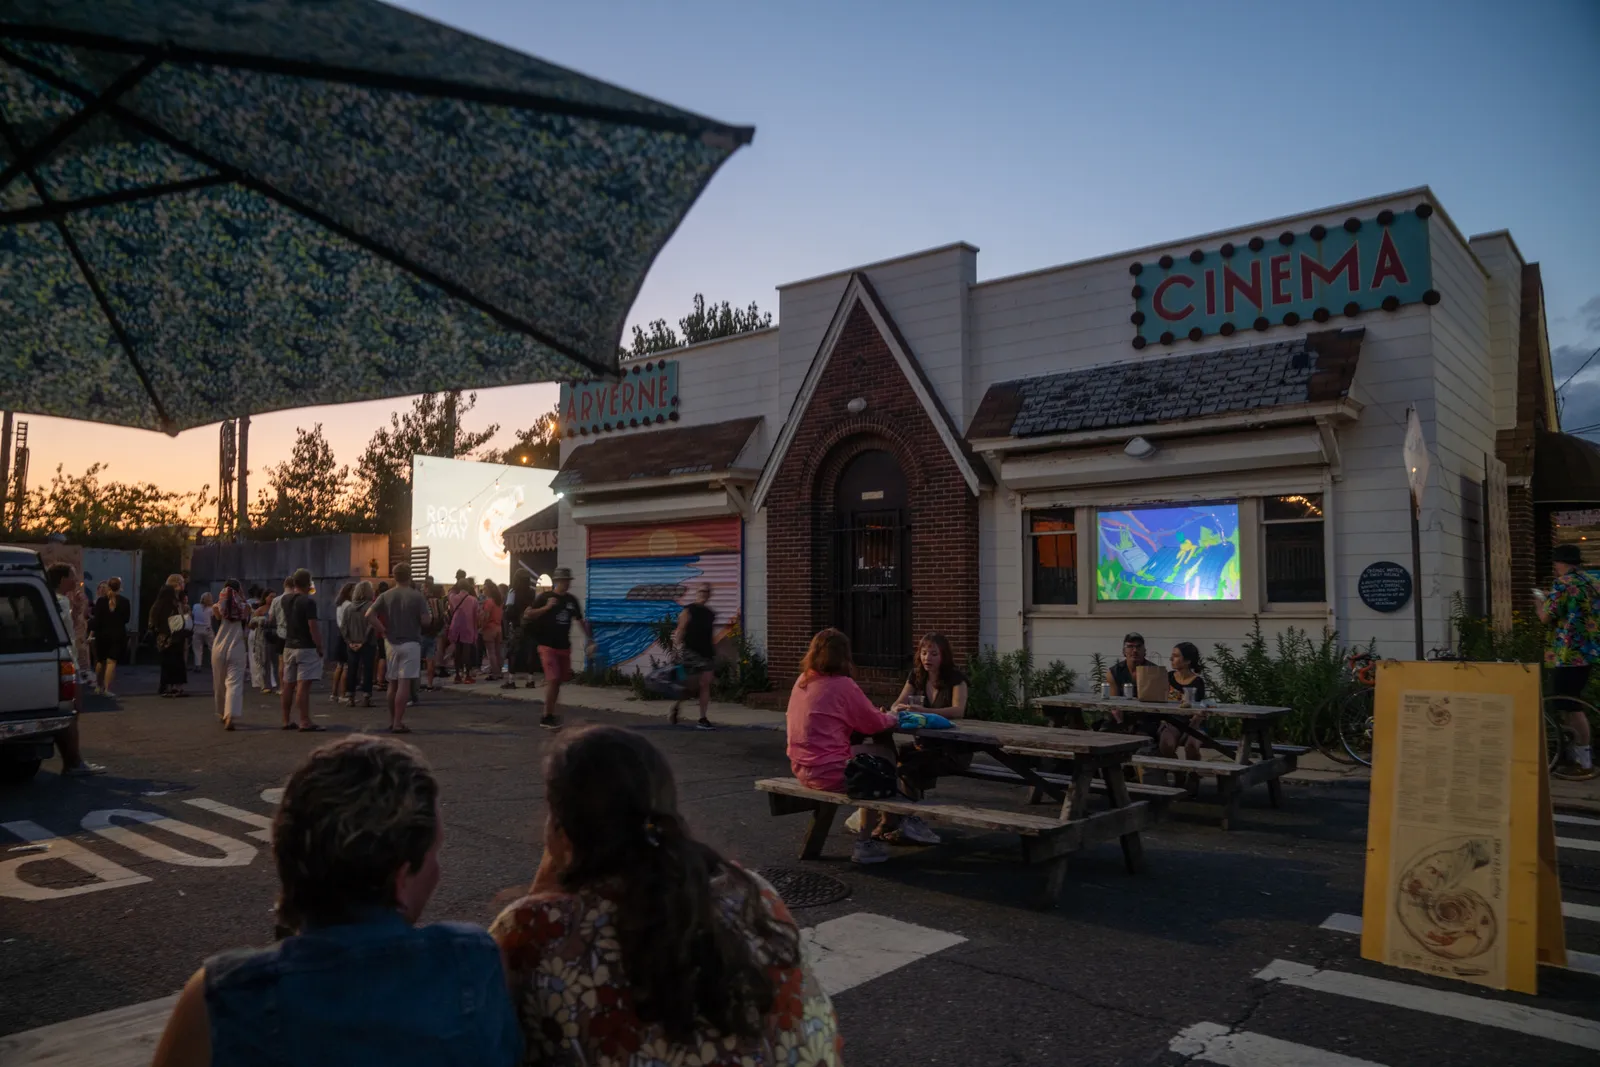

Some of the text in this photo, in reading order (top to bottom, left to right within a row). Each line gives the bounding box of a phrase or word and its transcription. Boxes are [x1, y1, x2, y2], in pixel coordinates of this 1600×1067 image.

[1152, 227, 1409, 321] CINEMA
[566, 375, 668, 423] ARVERNE
[426, 504, 468, 523] ROCK
[426, 523, 468, 540] AWAY
[505, 530, 558, 547] TICKETS
[0, 787, 285, 901] TOP
